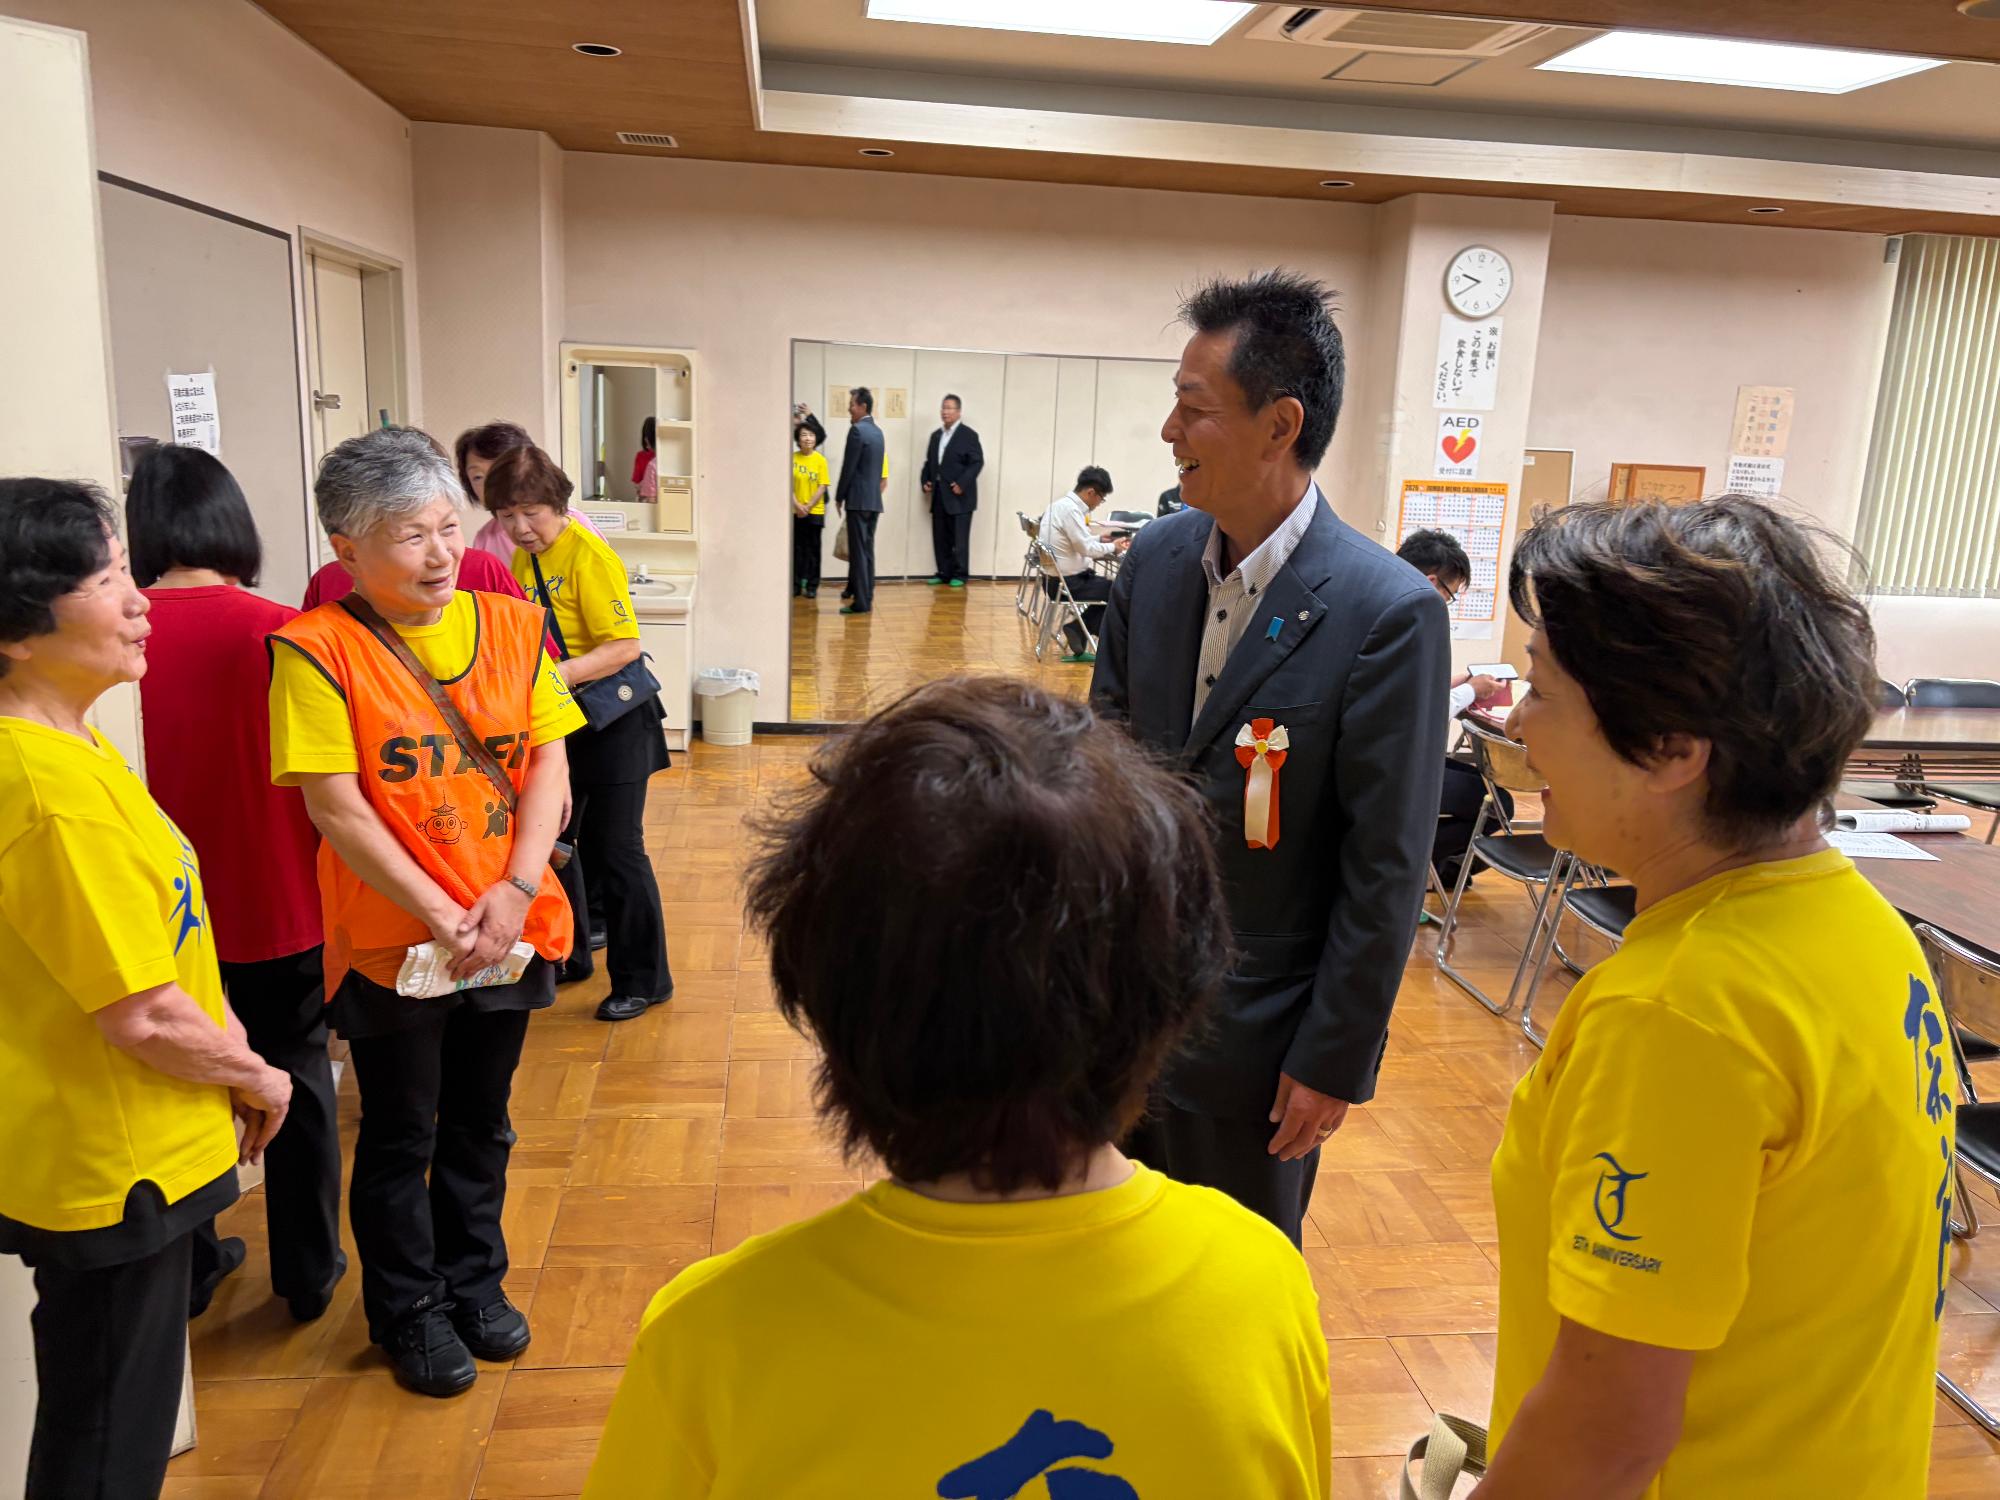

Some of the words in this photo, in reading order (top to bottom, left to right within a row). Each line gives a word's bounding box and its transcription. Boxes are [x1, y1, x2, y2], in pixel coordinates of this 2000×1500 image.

[1452, 338, 1466, 397] 飲食しないで
[1468, 329, 1481, 378] この部屋で
[1442, 416, 1480, 428] AED
[1439, 467, 1472, 475] 受付に設置
